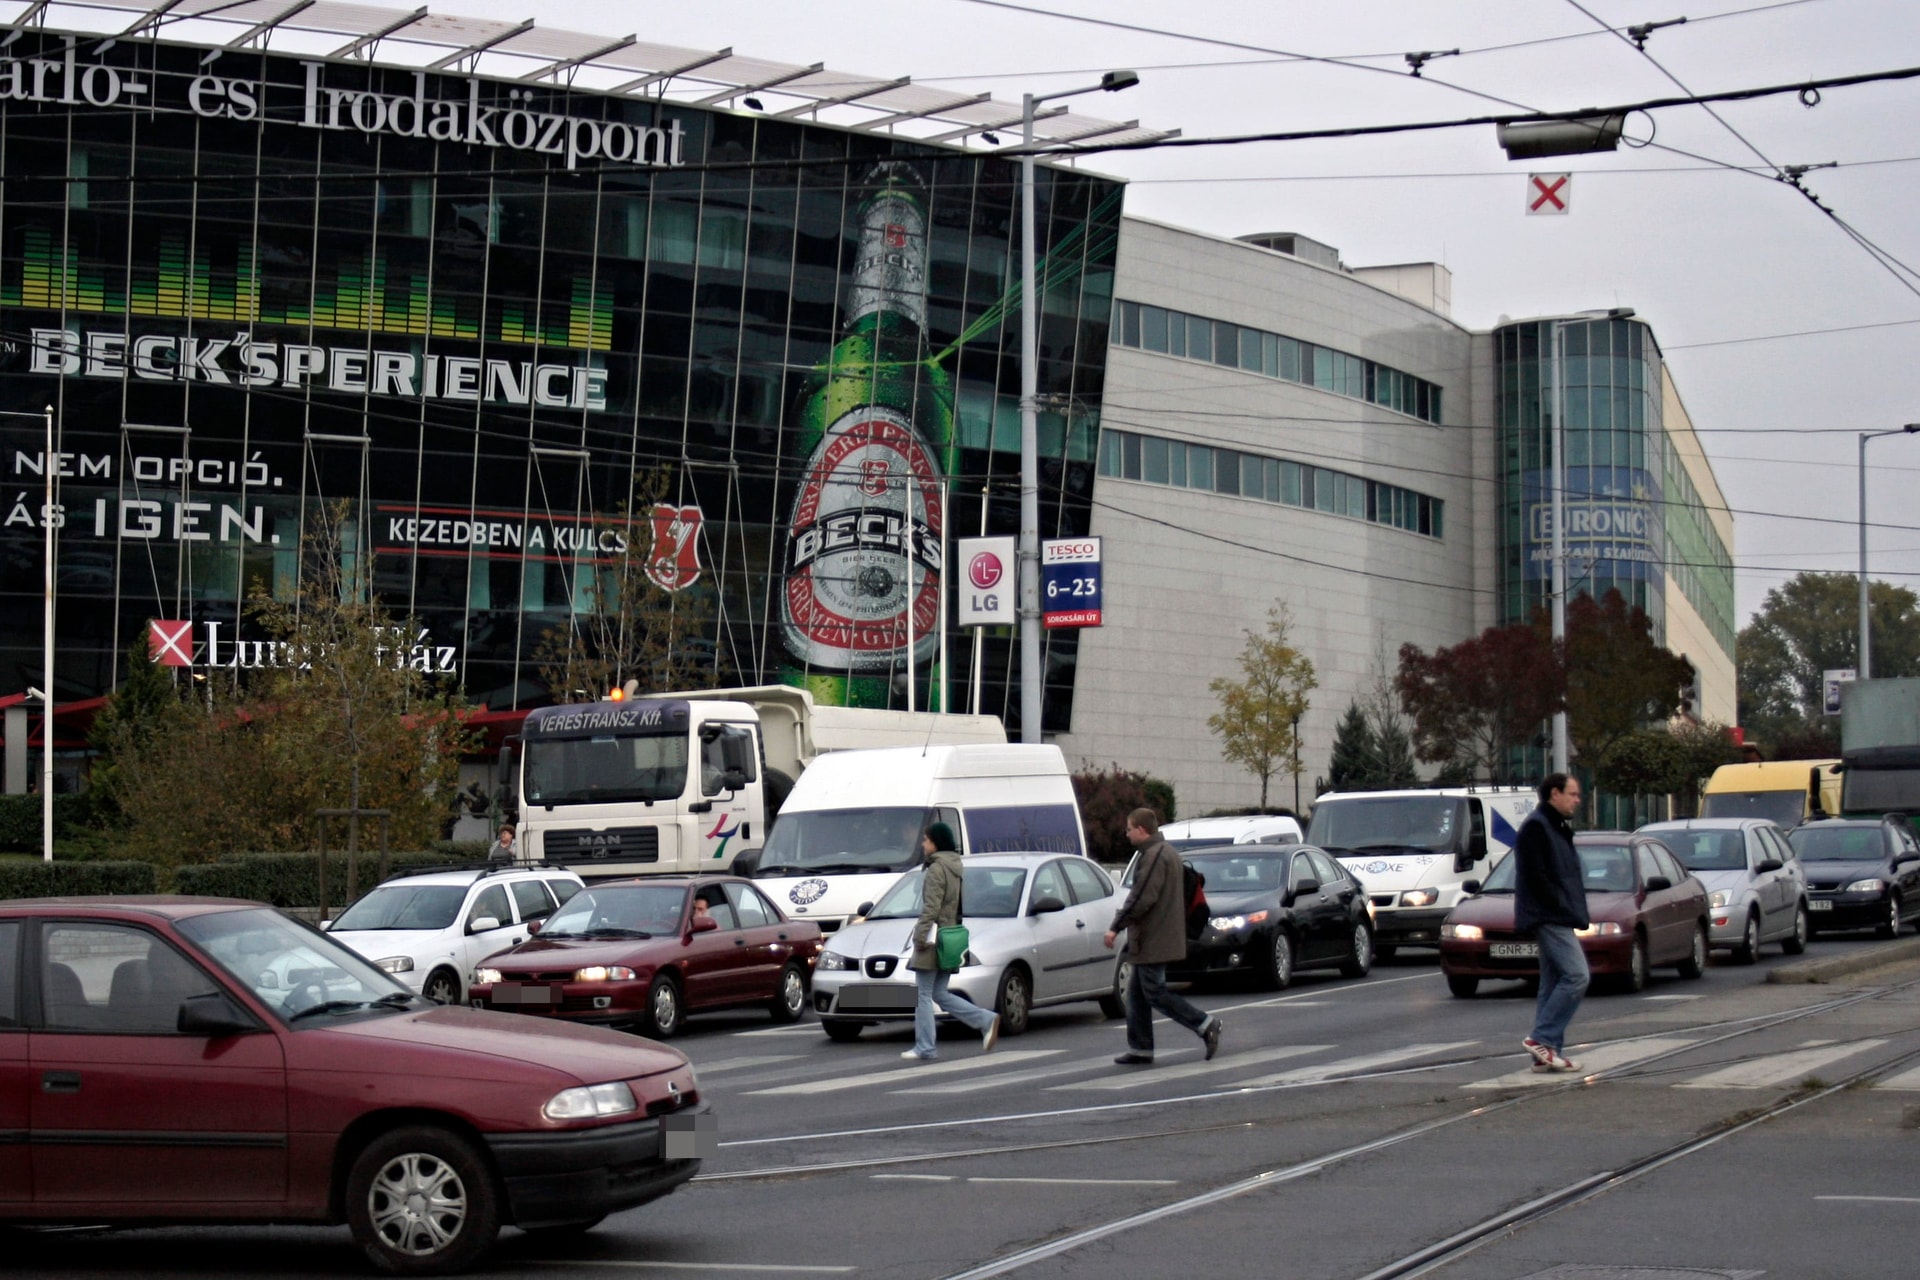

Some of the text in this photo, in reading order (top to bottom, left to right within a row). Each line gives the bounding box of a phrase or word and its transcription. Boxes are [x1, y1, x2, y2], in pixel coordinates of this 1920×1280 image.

[188, 49, 258, 121] és
[299, 61, 686, 176] Irodaközpont
[28, 328, 609, 412] BECK'SPERIENCE
[15, 450, 283, 487] NEM OPCIÓ.
[95, 498, 280, 543] IGEN.
[388, 517, 629, 554] KEZEDBEN A KULCS
[795, 513, 942, 569] BECK'S
[1048, 543, 1094, 555] TESCO
[971, 593, 999, 612] LG
[1047, 577, 1096, 598] 6-23
[1047, 611, 1097, 623] SOROKSÁRI ÚT
[539, 710, 662, 733] VERESTRANSZ Kft.
[578, 835, 621, 846] MAN
